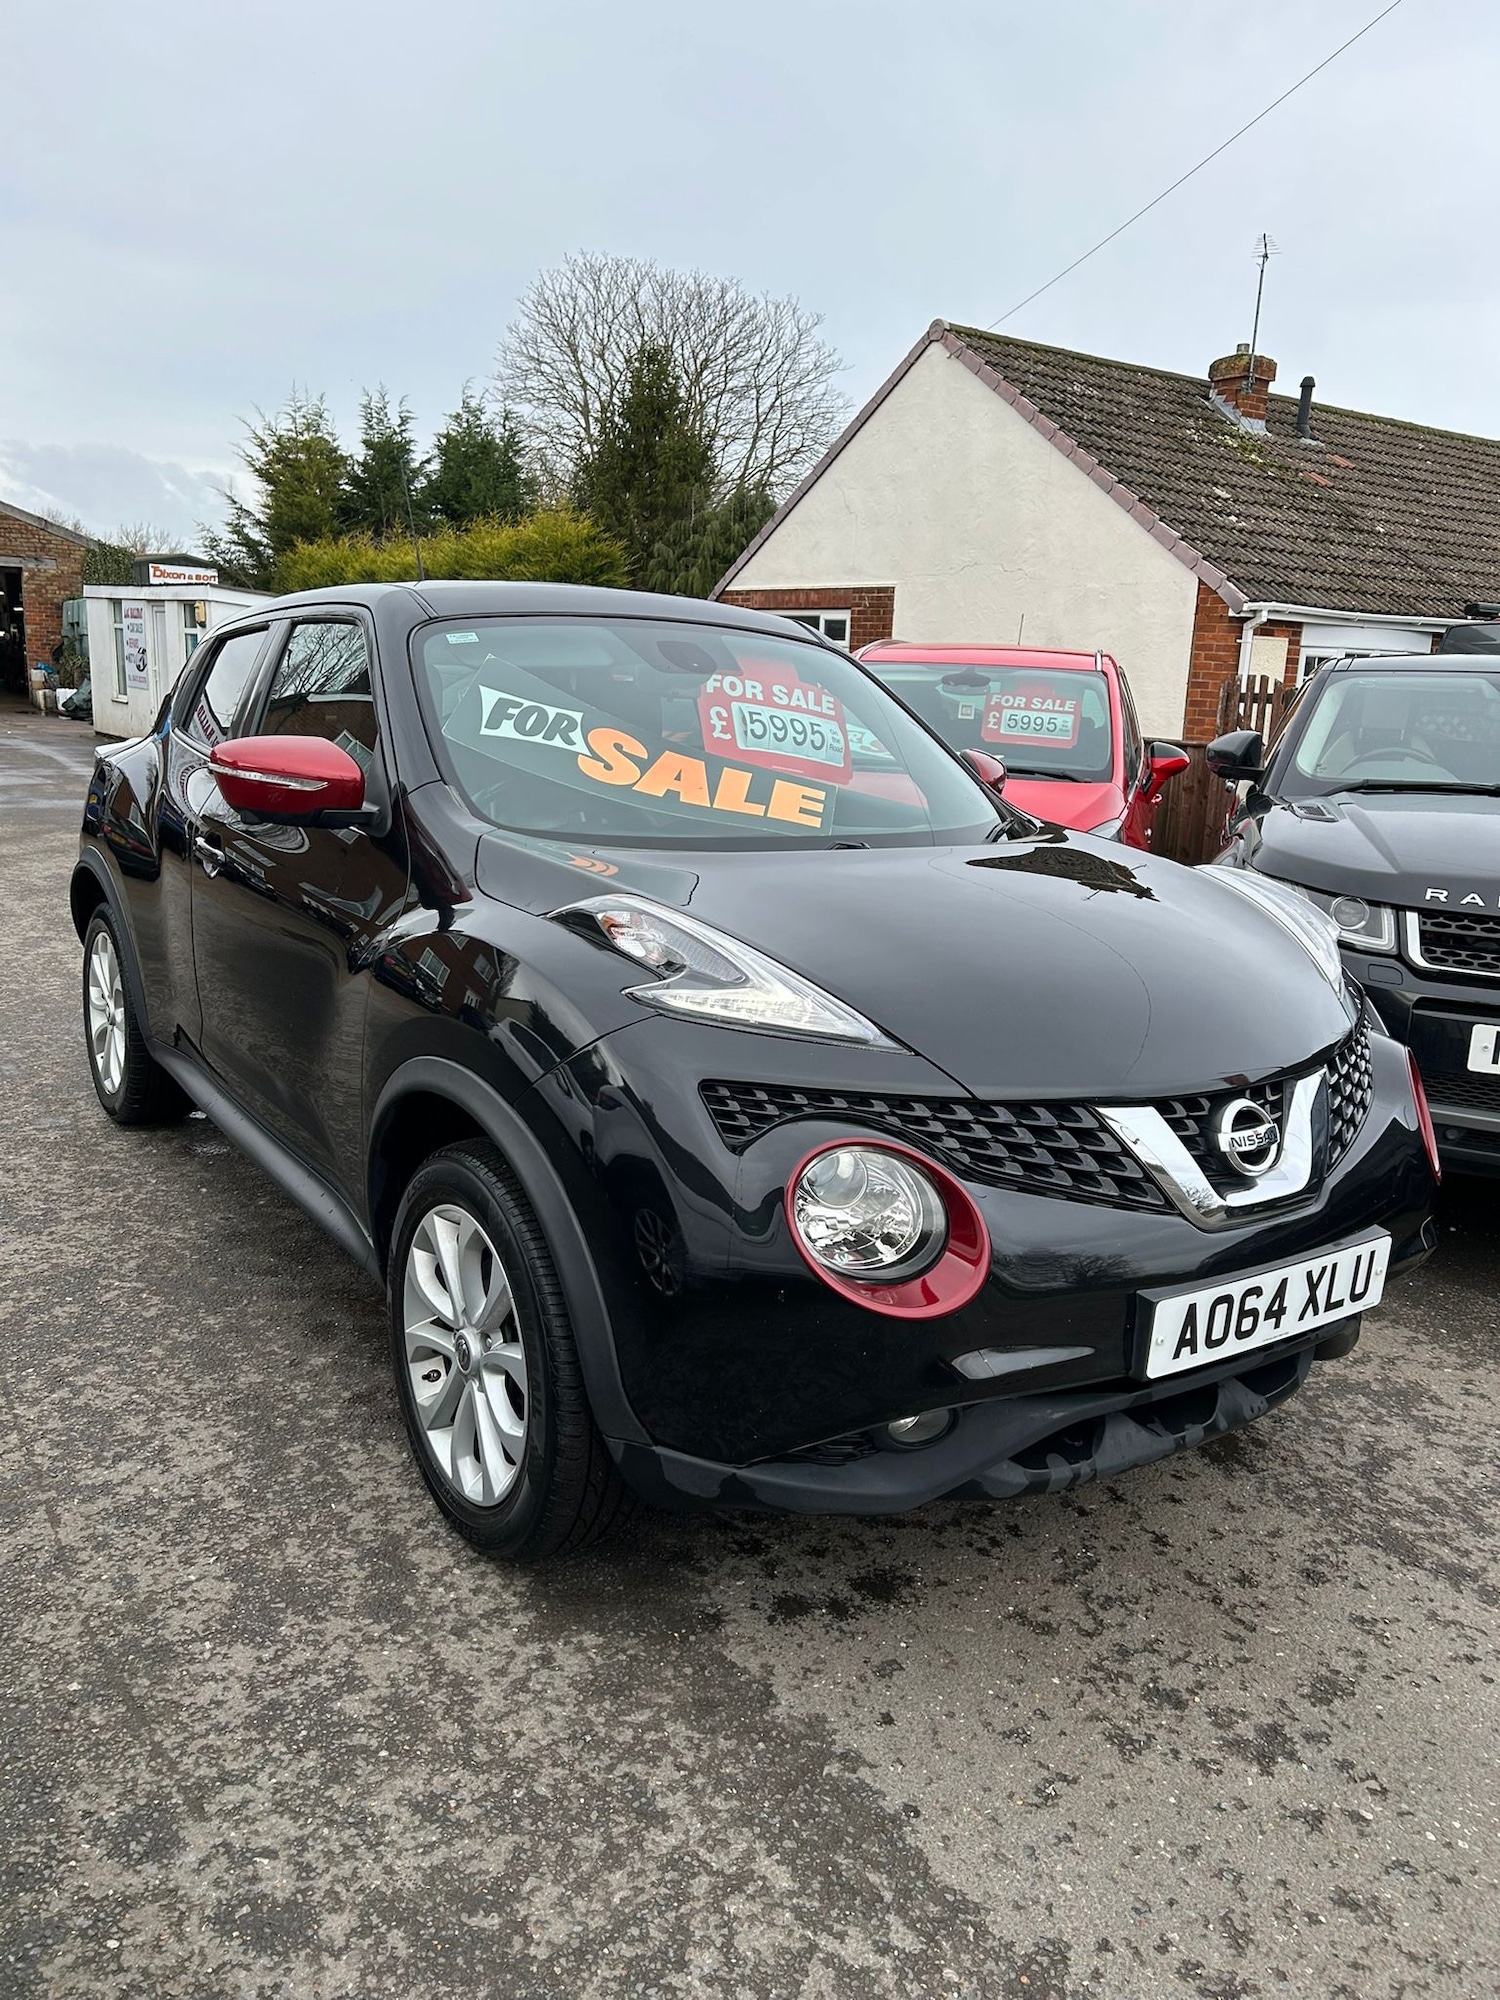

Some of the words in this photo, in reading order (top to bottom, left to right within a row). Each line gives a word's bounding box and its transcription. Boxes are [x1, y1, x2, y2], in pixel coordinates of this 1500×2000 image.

[706, 674, 764, 701] FOR
[772, 684, 836, 716] SALE
[990, 694, 1027, 708] FOR
[1031, 697, 1077, 712] SALE
[748, 710, 826, 751] 5995
[1007, 713, 1058, 733] 5995
[484, 697, 579, 746] FOR
[577, 727, 826, 828] SALE
[1172, 1277, 1289, 1361] AO64
[1298, 1249, 1377, 1322] XLU
